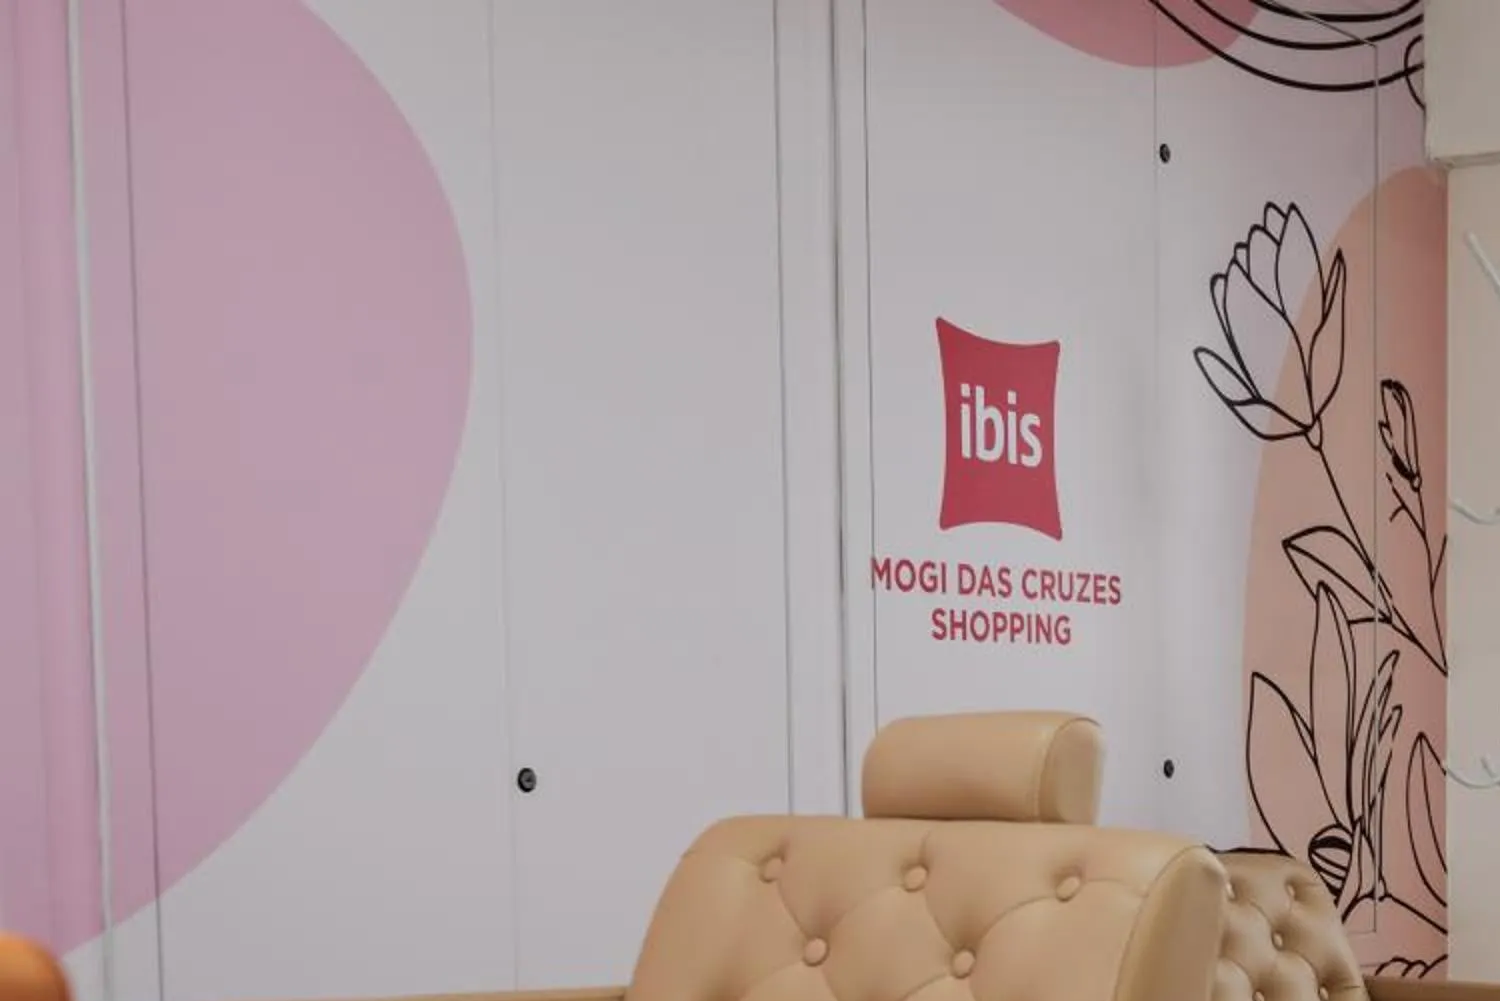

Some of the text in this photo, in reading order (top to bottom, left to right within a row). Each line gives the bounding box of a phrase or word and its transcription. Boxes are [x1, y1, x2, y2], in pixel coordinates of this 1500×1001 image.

[960, 383, 1042, 467] ibis
[870, 556, 1122, 605] MOGI DAS CRUZES
[931, 608, 1072, 645] SHOPPING
